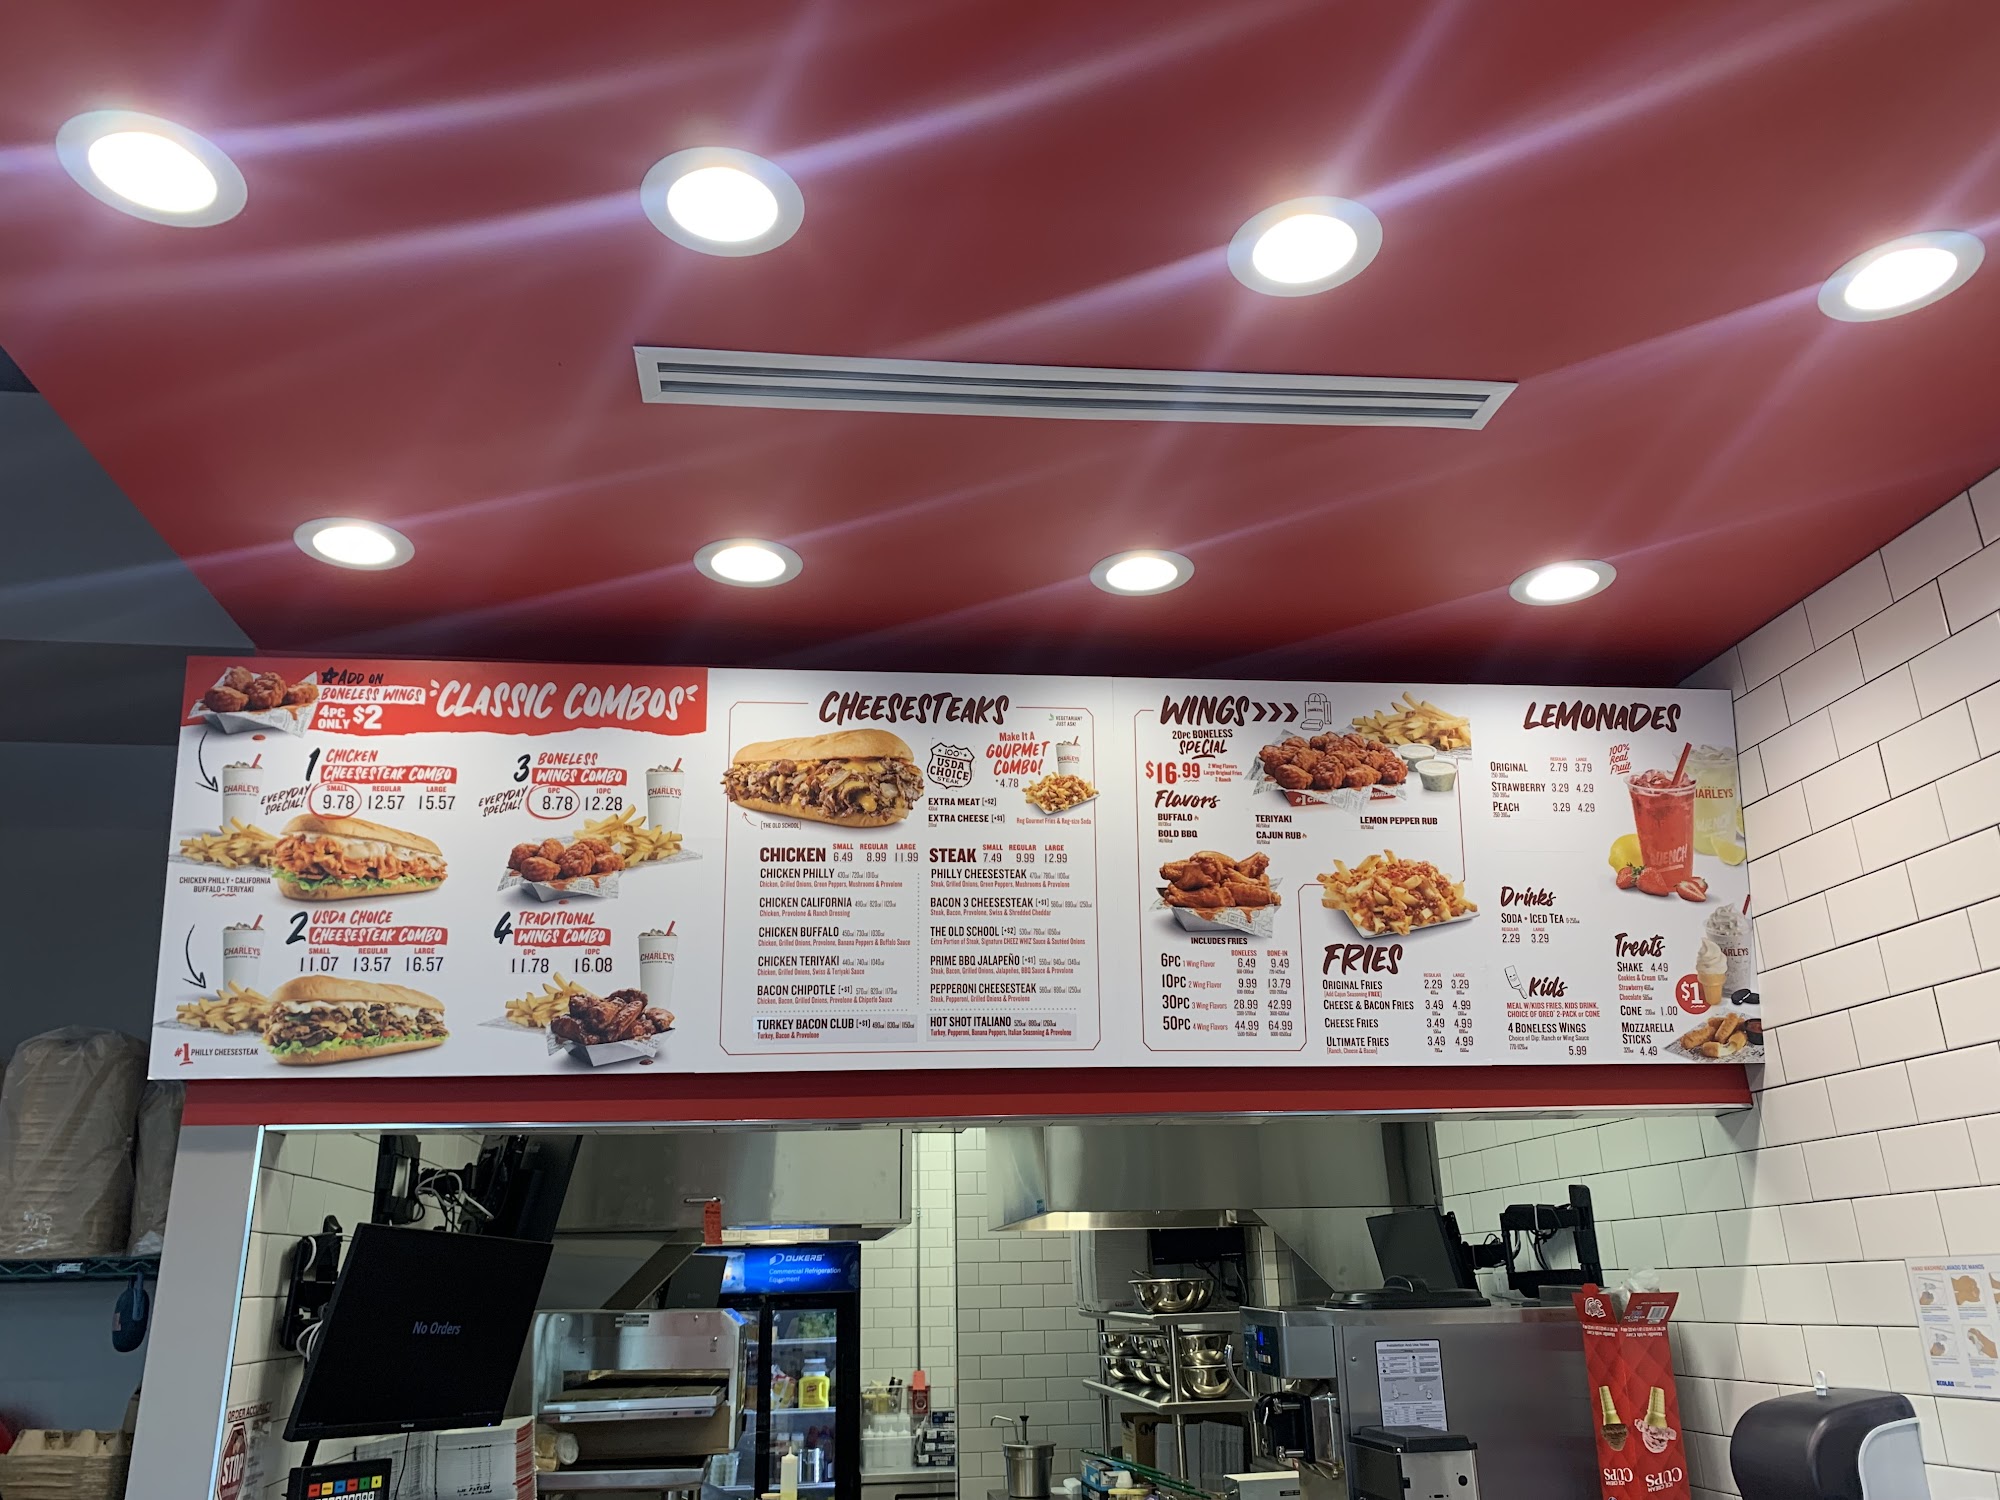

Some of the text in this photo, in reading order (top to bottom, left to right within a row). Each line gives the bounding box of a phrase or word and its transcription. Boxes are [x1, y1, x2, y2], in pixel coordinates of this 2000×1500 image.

[338, 669, 384, 685] ADD ON
[321, 687, 423, 702] BONELESS WINGS
[436, 680, 685, 721] CLASSIC COMBOS
[818, 691, 1010, 725] CHEESESTEAKS
[1160, 695, 1250, 727] WINGS
[319, 704, 383, 730] 4PC $2
[1523, 700, 1682, 732] LEMONADES
[318, 719, 350, 730] ONLY
[999, 732, 1035, 741] Make It A
[1172, 729, 1233, 740] 20PC BONELESS
[986, 741, 1050, 759] GOURMET
[1179, 739, 1228, 755] SPECIAL
[1609, 743, 1631, 756] 100%
[326, 749, 378, 763] CHICKEN
[538, 752, 598, 766] BONELESS
[1610, 751, 1628, 766] Real
[306, 748, 320, 781] 1
[514, 754, 530, 783] 3
[937, 757, 965, 771] USDA
[993, 759, 1043, 776] COMBO!
[1490, 761, 1593, 773] ORIGINAL 2.79 3.79
[323, 766, 452, 782] CHEESESTEAK COMBO
[536, 768, 623, 784] WINGS COMBO
[929, 766, 970, 781] CHOICE
[1145, 760, 1201, 784] $16.99
[937, 776, 959, 785] STEAK
[1491, 780, 1546, 792] STRAWBERRY
[1551, 783, 1569, 793] 3.29
[1576, 783, 1594, 793] 4.29
[223, 785, 260, 794] CHARLEYS
[261, 784, 311, 805] EVERYDAY
[372, 785, 402, 793] REGULAR
[264, 798, 306, 815] SPECIAL!
[323, 795, 455, 811] 9.78 12.57 15.57
[542, 796, 623, 811] 8.78 12.28
[1154, 790, 1220, 809] Flavors
[1157, 813, 1193, 821] BUFFALO
[1255, 815, 1292, 823] TERIYAKI
[1360, 816, 1438, 825] LEMON PEPPER RUB
[760, 847, 919, 862] CHICKEN 6.49 8.99 11.99
[929, 848, 1068, 863] STEAK 7.49 9.99 12.99
[179, 876, 271, 885] CHICKEN PHILLY CALIFORNIA
[193, 885, 254, 893] BUFFALO TERIYAKI
[1500, 886, 1557, 907] Drinks
[759, 897, 852, 908] CHICKEN CALIFORNIA
[312, 910, 393, 925] USDA CHOICE
[518, 911, 595, 926] TRADITIONAL
[1501, 913, 1522, 924] SODA
[1549, 914, 1564, 924] TEA
[286, 911, 308, 945] 2
[494, 911, 513, 944] 4
[930, 926, 1000, 937] THE OLD SCHOOL
[311, 928, 443, 943] CHEESESTEAK COMBO
[518, 929, 606, 944] WINGS COMBO
[1502, 933, 1549, 944] 2.29 3.29
[1615, 932, 1666, 957] Treats
[300, 957, 444, 972] 11.07 13.57 16.57
[640, 953, 675, 962] CHARLEYS
[930, 953, 1020, 966] PRIME BBQ JALAPEÑO
[1161, 953, 1289, 968] 6PC 6.49 9.49
[1323, 944, 1403, 975] FRIES
[511, 957, 613, 974] 11.78 16.08
[1617, 961, 1669, 973] SHAKE 4.49
[1323, 979, 1470, 990] ORIGINAL FRIES 2.29 3.29
[1528, 976, 1569, 998] Kids
[1681, 981, 1703, 1005] $1
[1162, 995, 1292, 1010] 30PC 28.99 42.99
[757, 1018, 854, 1030] TURKEY BACON CLUB
[930, 1016, 1012, 1027] HOT SHOT ITALIANO
[1508, 1022, 1587, 1034] 4 BONELESS WINGS
[1621, 1022, 1674, 1033] MOZZARELLA
[1622, 1034, 1651, 1044] STICKS
[191, 1048, 213, 1057] PHILLY
[214, 1048, 258, 1057] CHEESESTEAK
[1568, 1046, 1587, 1055] 5.99
[1640, 1046, 1658, 1055] 4.49
[804, 1267, 841, 1276] Refrigeration
[412, 1321, 461, 1335] No Orders
[228, 1407, 245, 1422] ORDER
[221, 1452, 245, 1487] STOP
[1603, 1468, 1634, 1483] CUPS
[1645, 1467, 1684, 1488] CUPS
